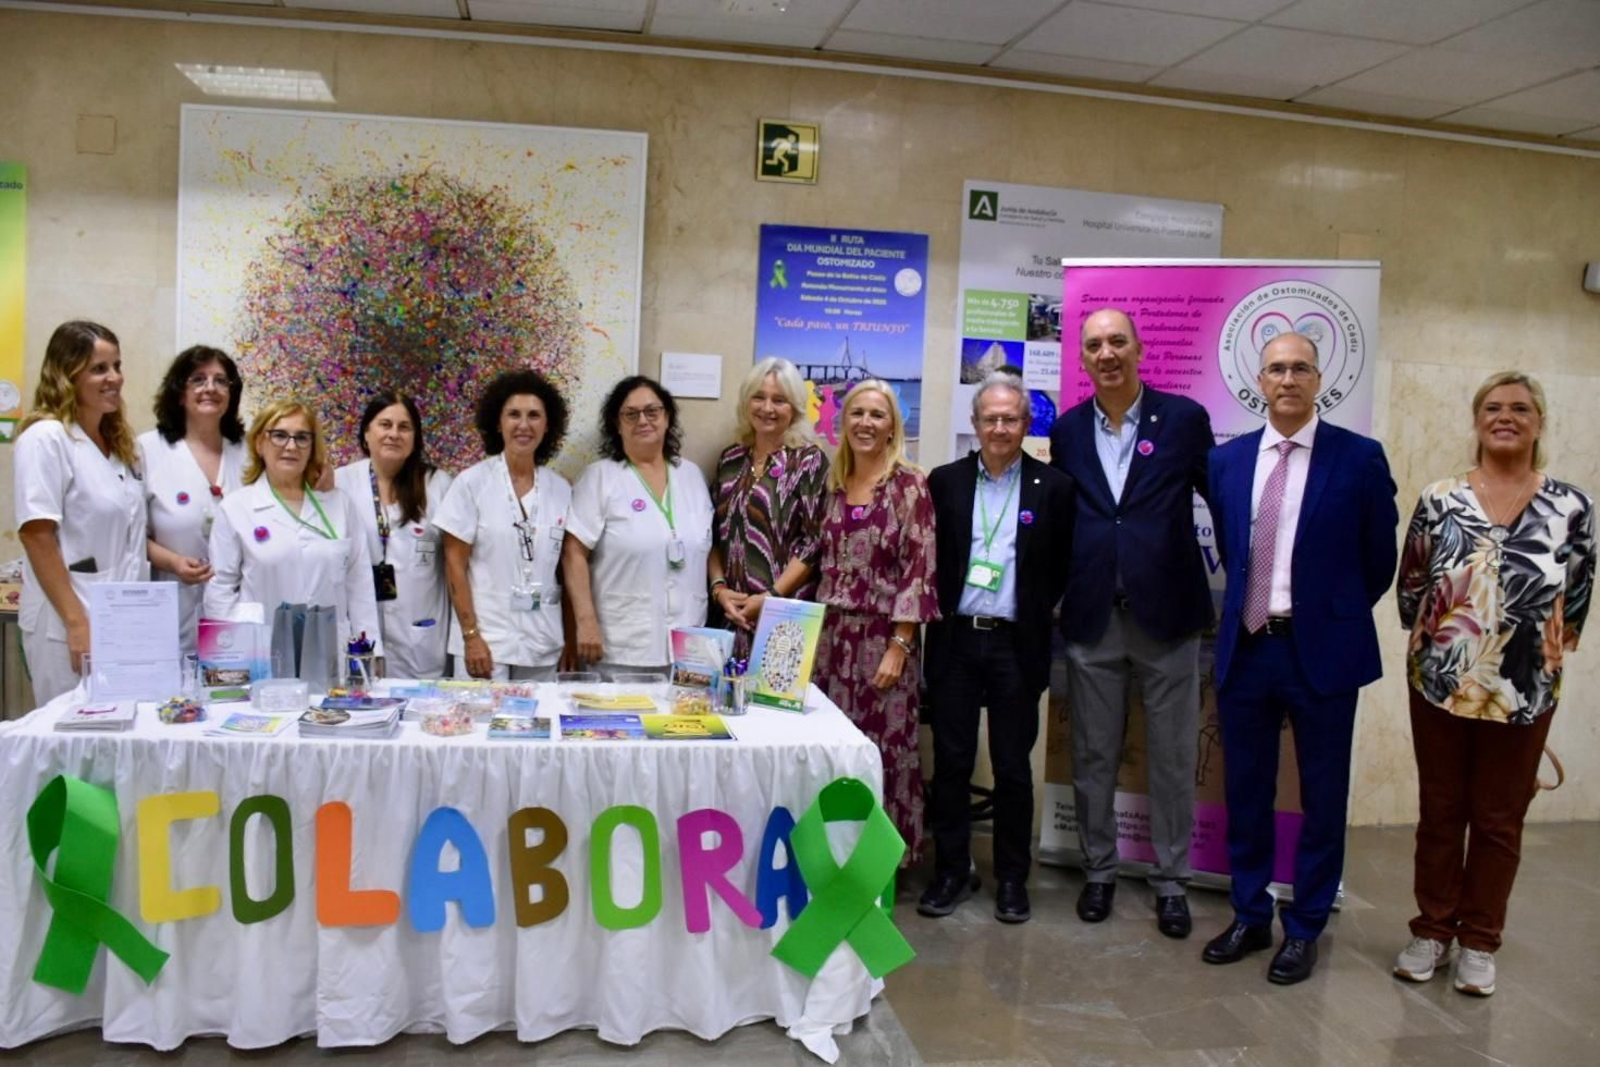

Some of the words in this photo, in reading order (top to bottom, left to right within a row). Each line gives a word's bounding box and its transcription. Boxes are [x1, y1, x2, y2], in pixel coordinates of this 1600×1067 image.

[1083, 219, 1112, 230] Hospital
[841, 235, 865, 244] RUTA
[804, 244, 846, 256] MUNDIAL
[847, 246, 862, 256] DEL
[863, 247, 906, 259] PACIENTE
[817, 257, 875, 268] OSTOMIZADO
[1032, 255, 1043, 265] Tu
[1045, 256, 1062, 266] Sal
[1015, 267, 1051, 279] Nuestro
[1223, 299, 1256, 352] Asociación
[1257, 293, 1269, 301] de
[1272, 286, 1339, 310] Ostomizados
[1338, 309, 1350, 323] de
[1346, 323, 1359, 353] Cádiz
[1237, 388, 1343, 414] OSTDES
[137, 791, 808, 933] COLABORA
